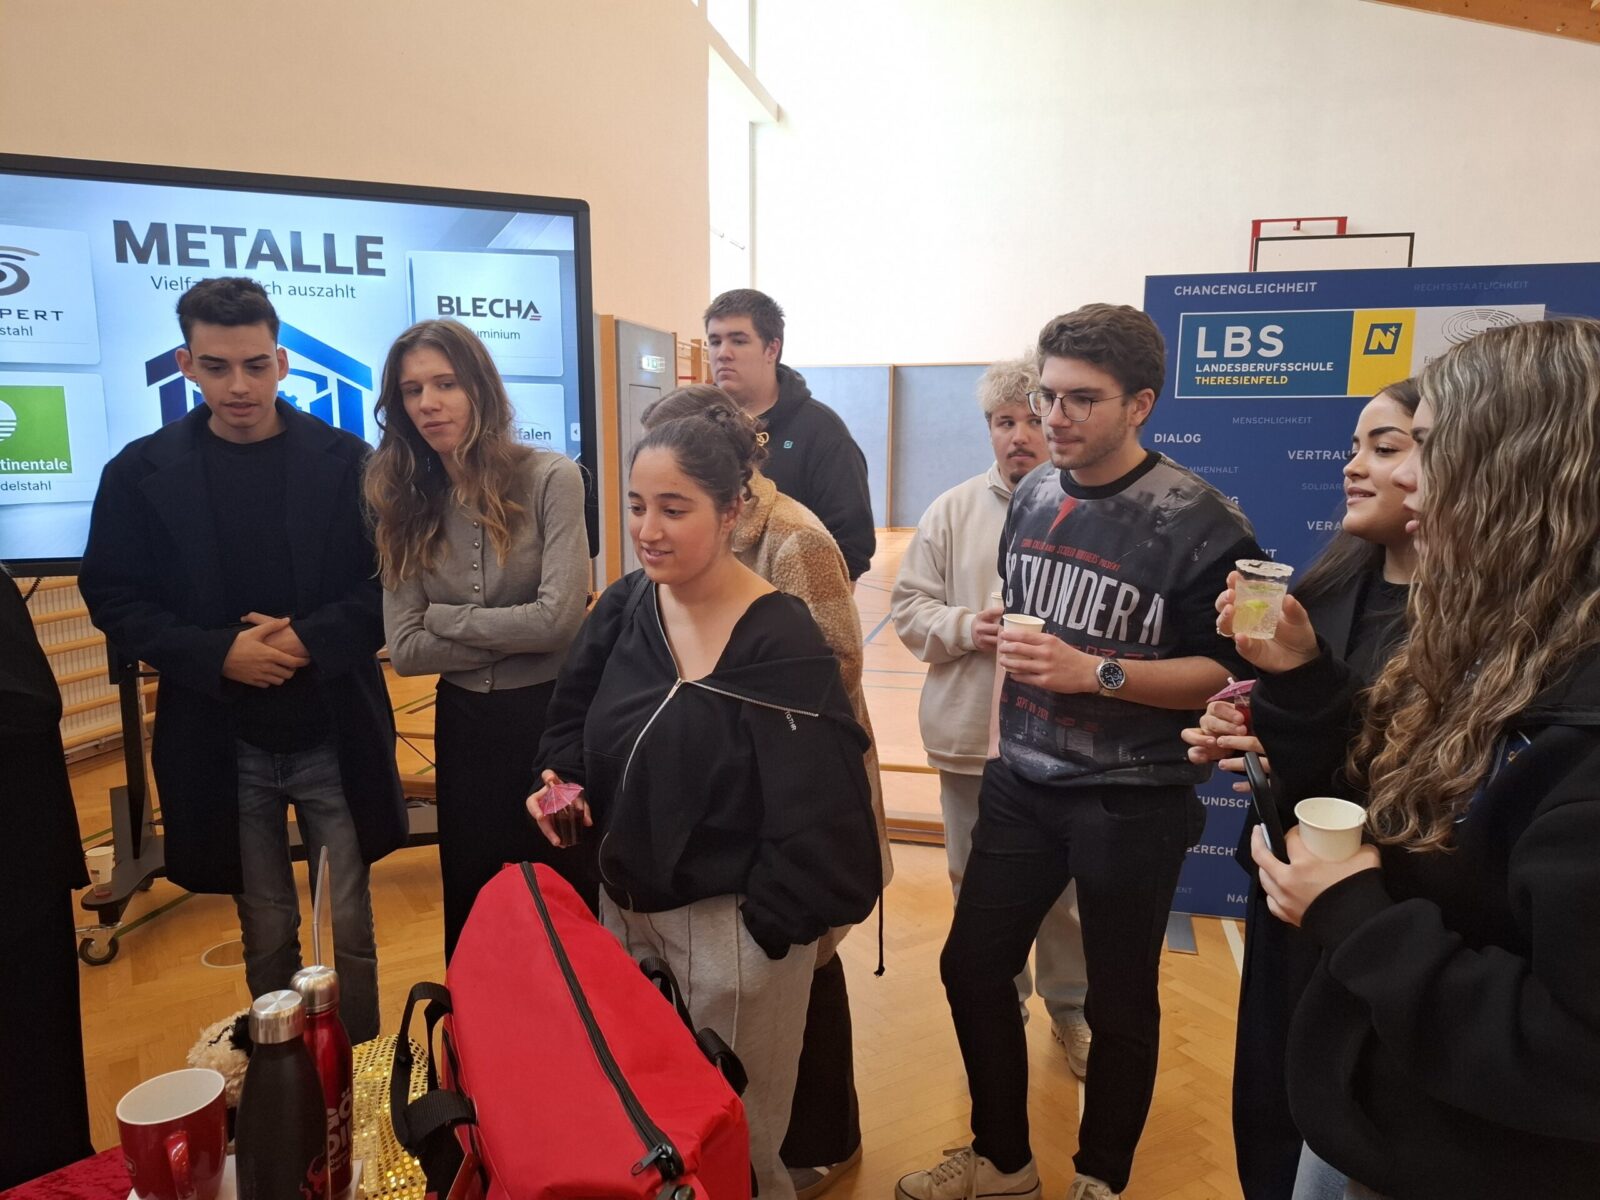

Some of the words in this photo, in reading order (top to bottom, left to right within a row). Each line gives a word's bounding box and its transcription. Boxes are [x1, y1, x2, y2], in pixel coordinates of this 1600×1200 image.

[113, 219, 386, 277] METALLE
[288, 283, 356, 299] auszahlt
[1174, 282, 1317, 296] CHANCENGLEICHHEIT
[1413, 281, 1529, 292] RECHTSSTAATLICHKEIT
[437, 295, 542, 321] BLECHA
[0, 308, 64, 321] PERT
[0, 325, 33, 337] stahl
[1196, 324, 1284, 358] LBS
[1195, 362, 1334, 373] LANDESBERUFSSCHULE
[1195, 375, 1289, 385] THERESIENFELD
[1232, 416, 1313, 425] MENSCHLICHKEIT
[518, 428, 552, 440] falen
[1153, 433, 1202, 444] DIALOG
[1287, 450, 1351, 460] VERTRAU
[0, 458, 68, 471] tinentale
[1186, 465, 1240, 474] MMENHALT
[0, 481, 52, 491] delstahl
[1301, 483, 1342, 491] SOLIDAR
[1306, 520, 1342, 531] VERA
[1197, 795, 1251, 808] UNDSC
